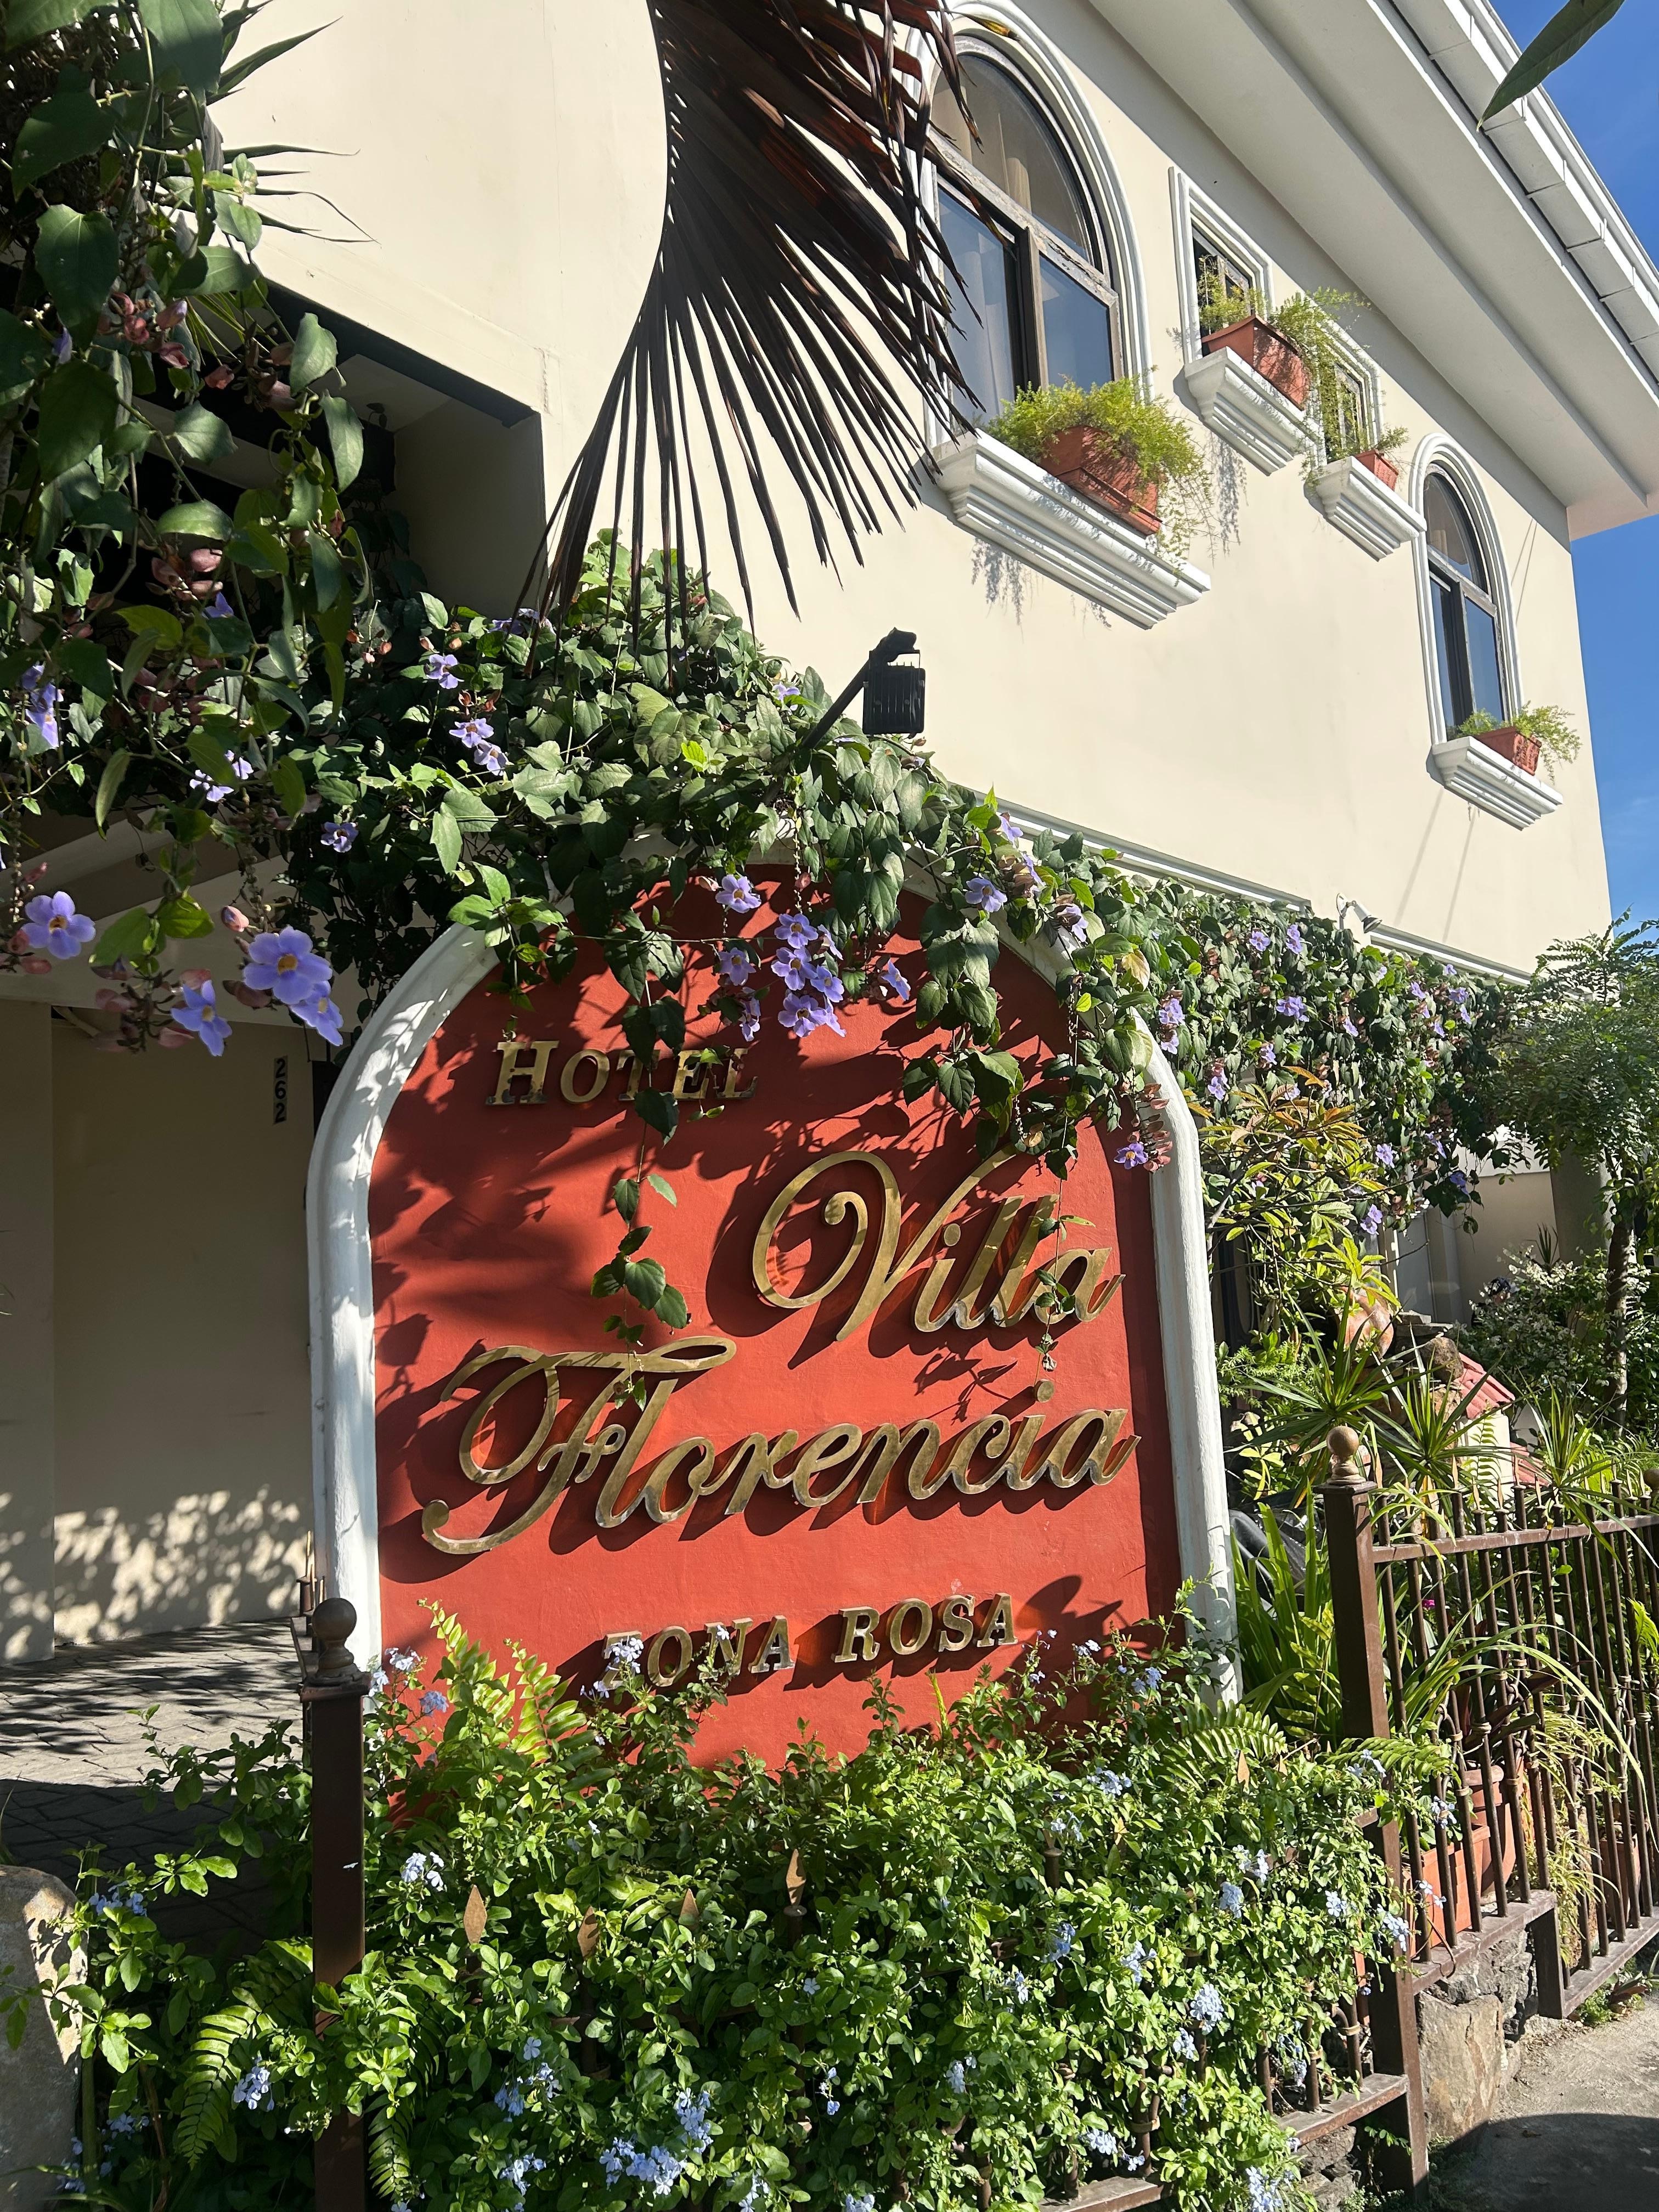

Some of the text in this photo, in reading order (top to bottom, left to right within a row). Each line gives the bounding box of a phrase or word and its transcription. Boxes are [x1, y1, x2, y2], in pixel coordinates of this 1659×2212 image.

[275, 1058, 286, 1122] 262
[485, 1040, 758, 1104] HOTEL
[752, 1142, 1126, 1341] Villa
[422, 1335, 1142, 1554] Florencia
[831, 1592, 1019, 1663] ROSA
